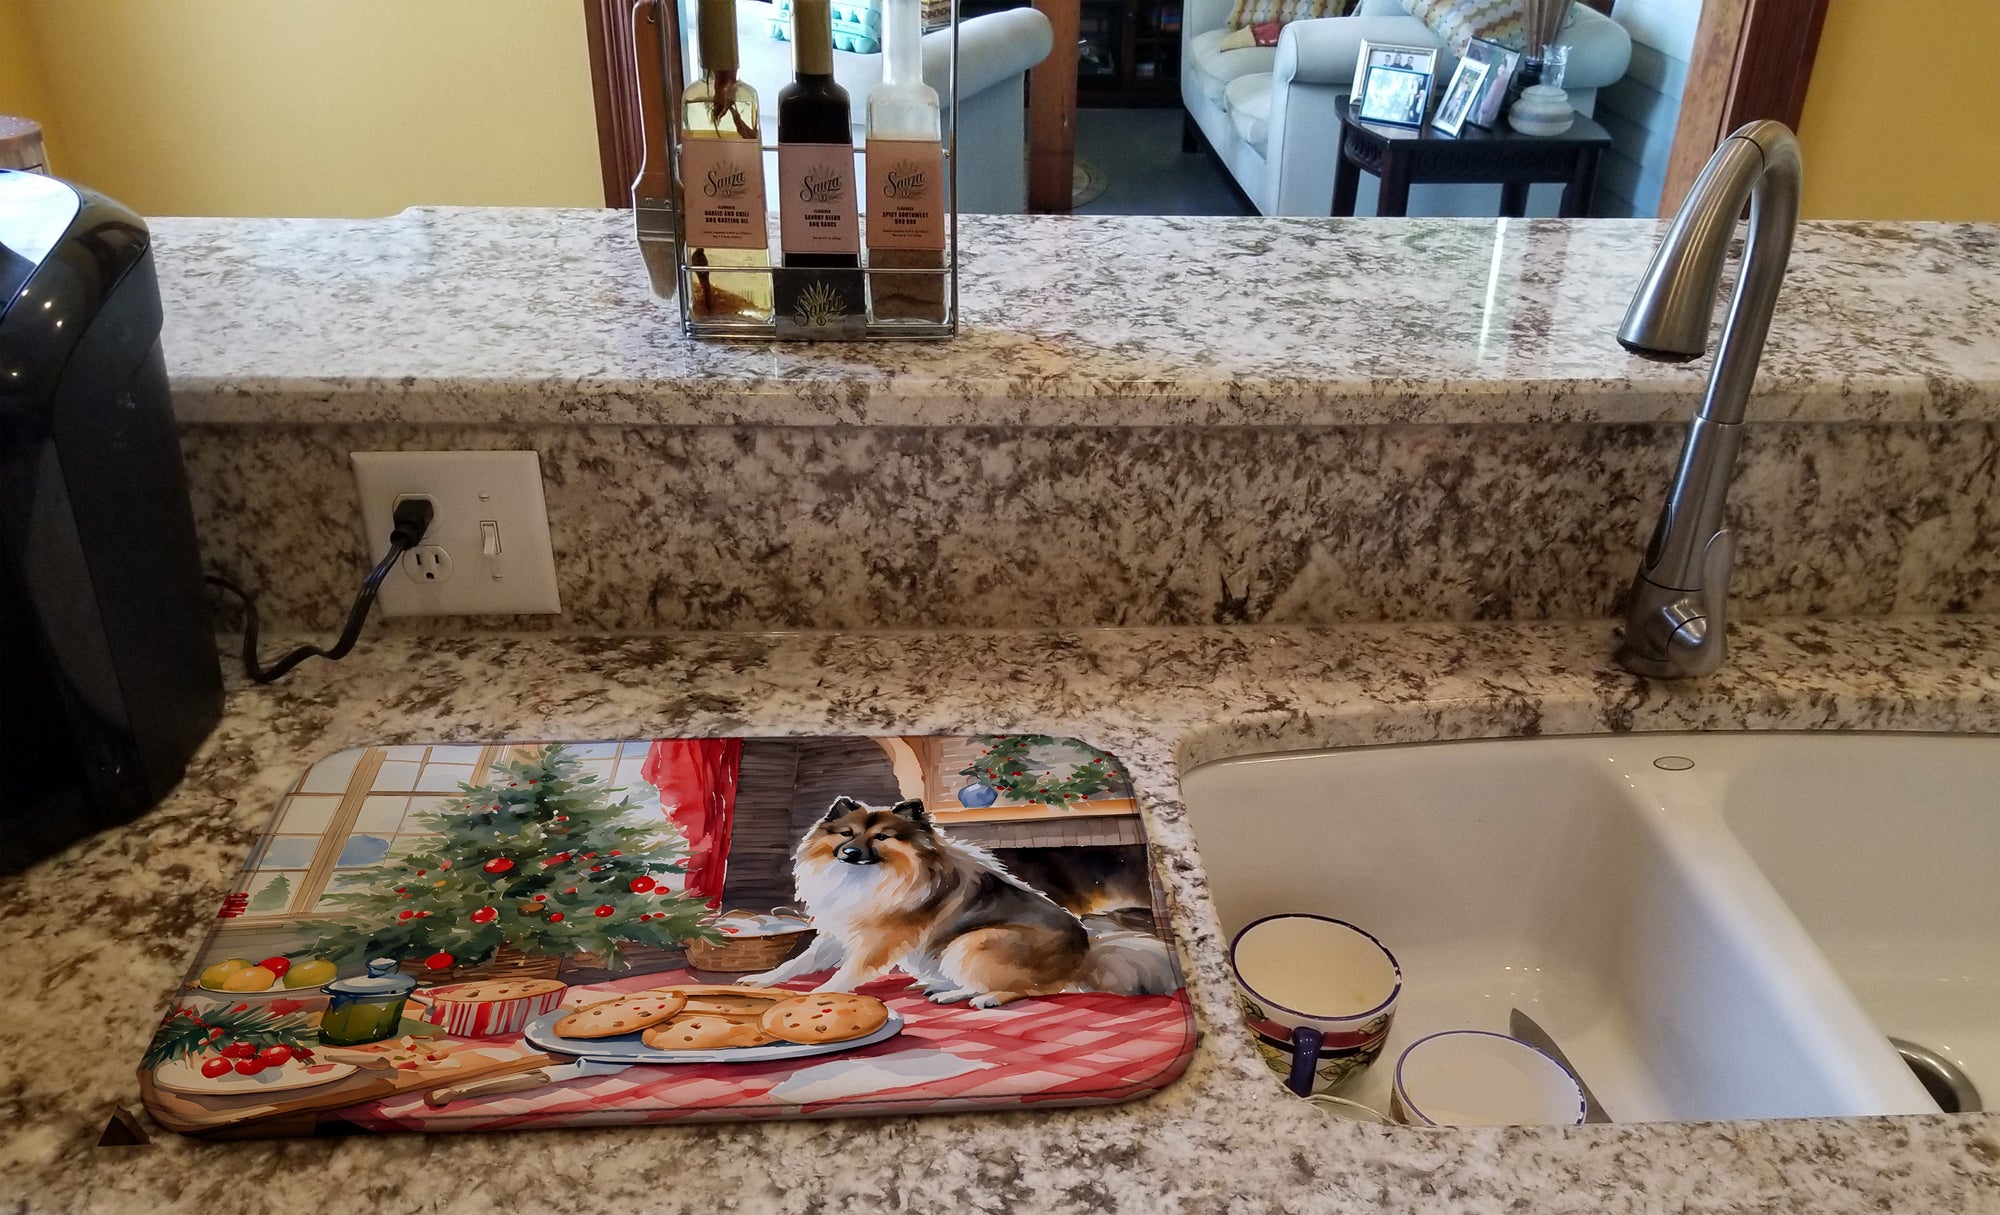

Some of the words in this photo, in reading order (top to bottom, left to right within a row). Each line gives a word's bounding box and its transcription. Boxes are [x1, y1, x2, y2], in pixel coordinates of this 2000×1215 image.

[704, 170, 746, 197] Sauza
[800, 175, 842, 202] Sauza
[884, 171, 925, 198] Sauza
